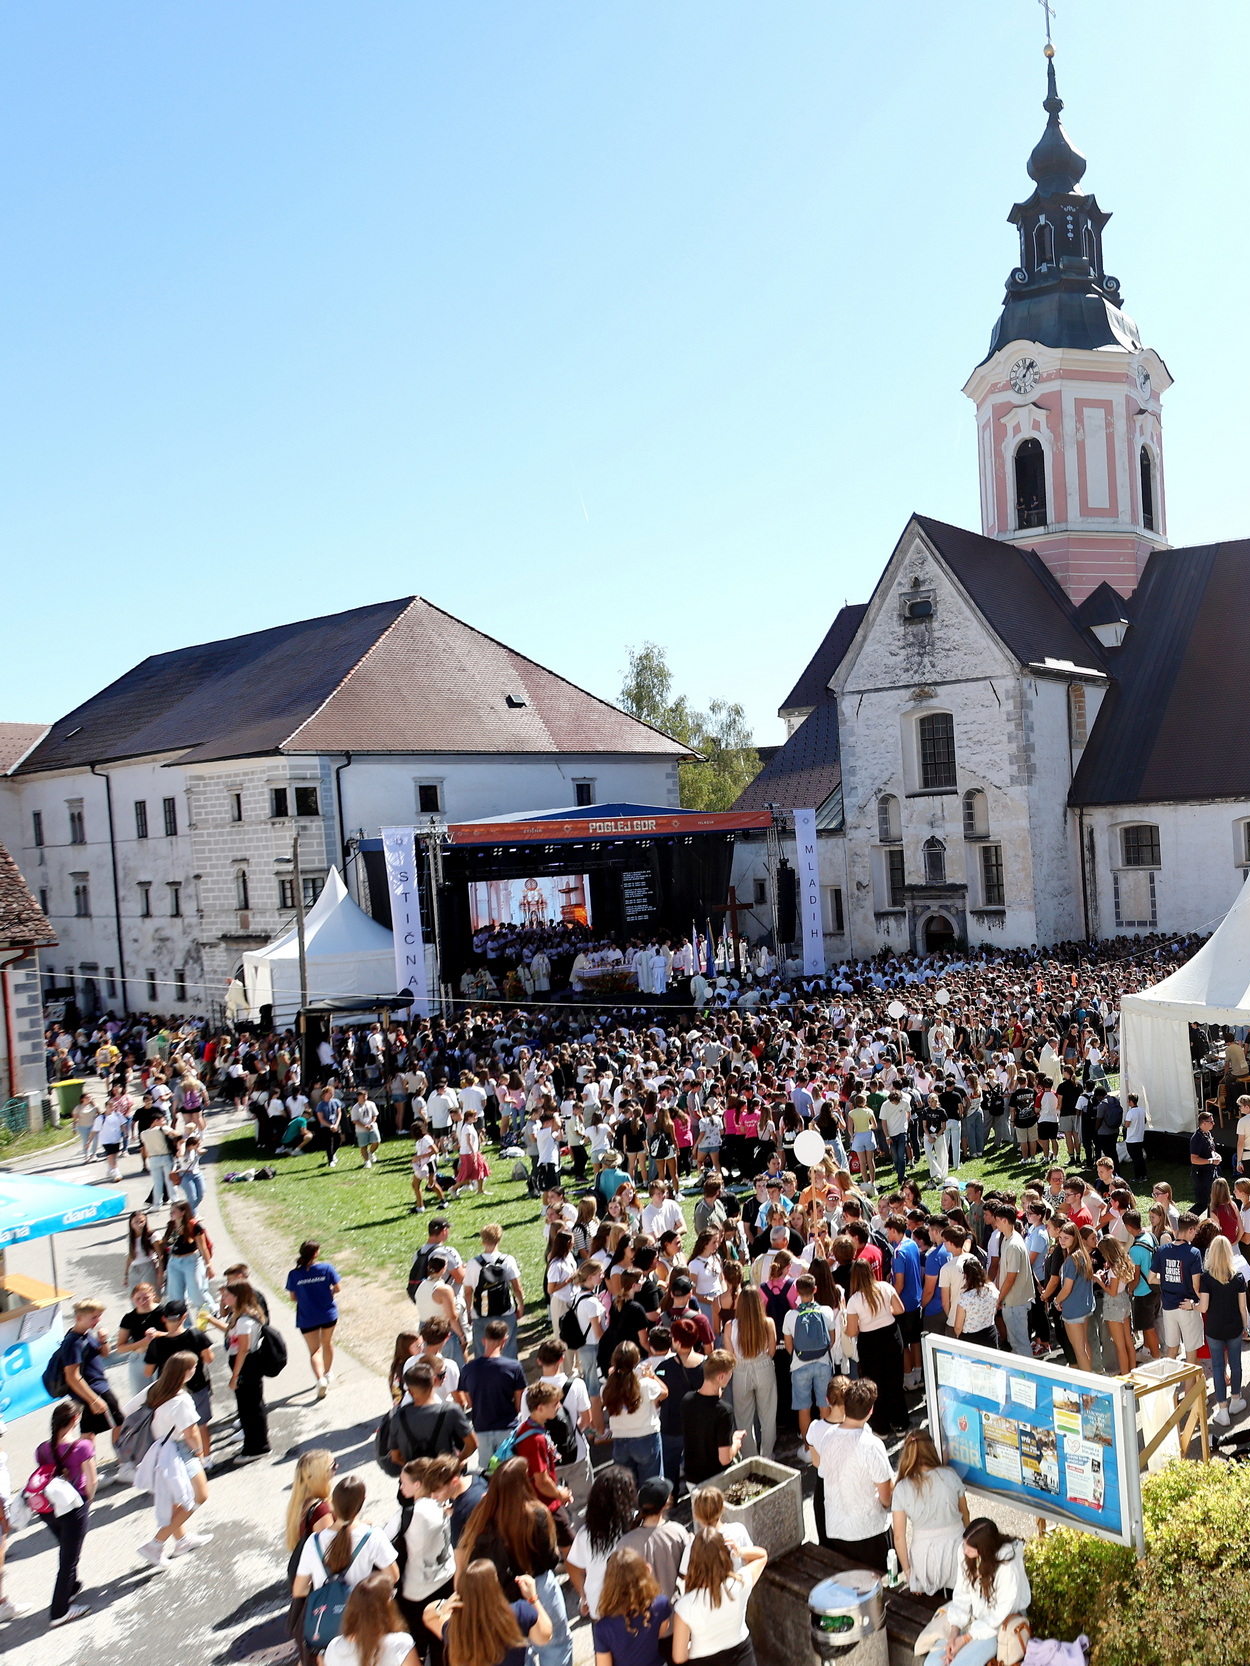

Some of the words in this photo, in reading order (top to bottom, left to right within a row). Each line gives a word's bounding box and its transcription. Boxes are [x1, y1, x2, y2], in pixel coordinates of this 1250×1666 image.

[589, 821, 631, 834] POGLEJ
[633, 819, 657, 831] GOR
[399, 871, 419, 986] STIČNA
[804, 845, 819, 938] MLADIH
